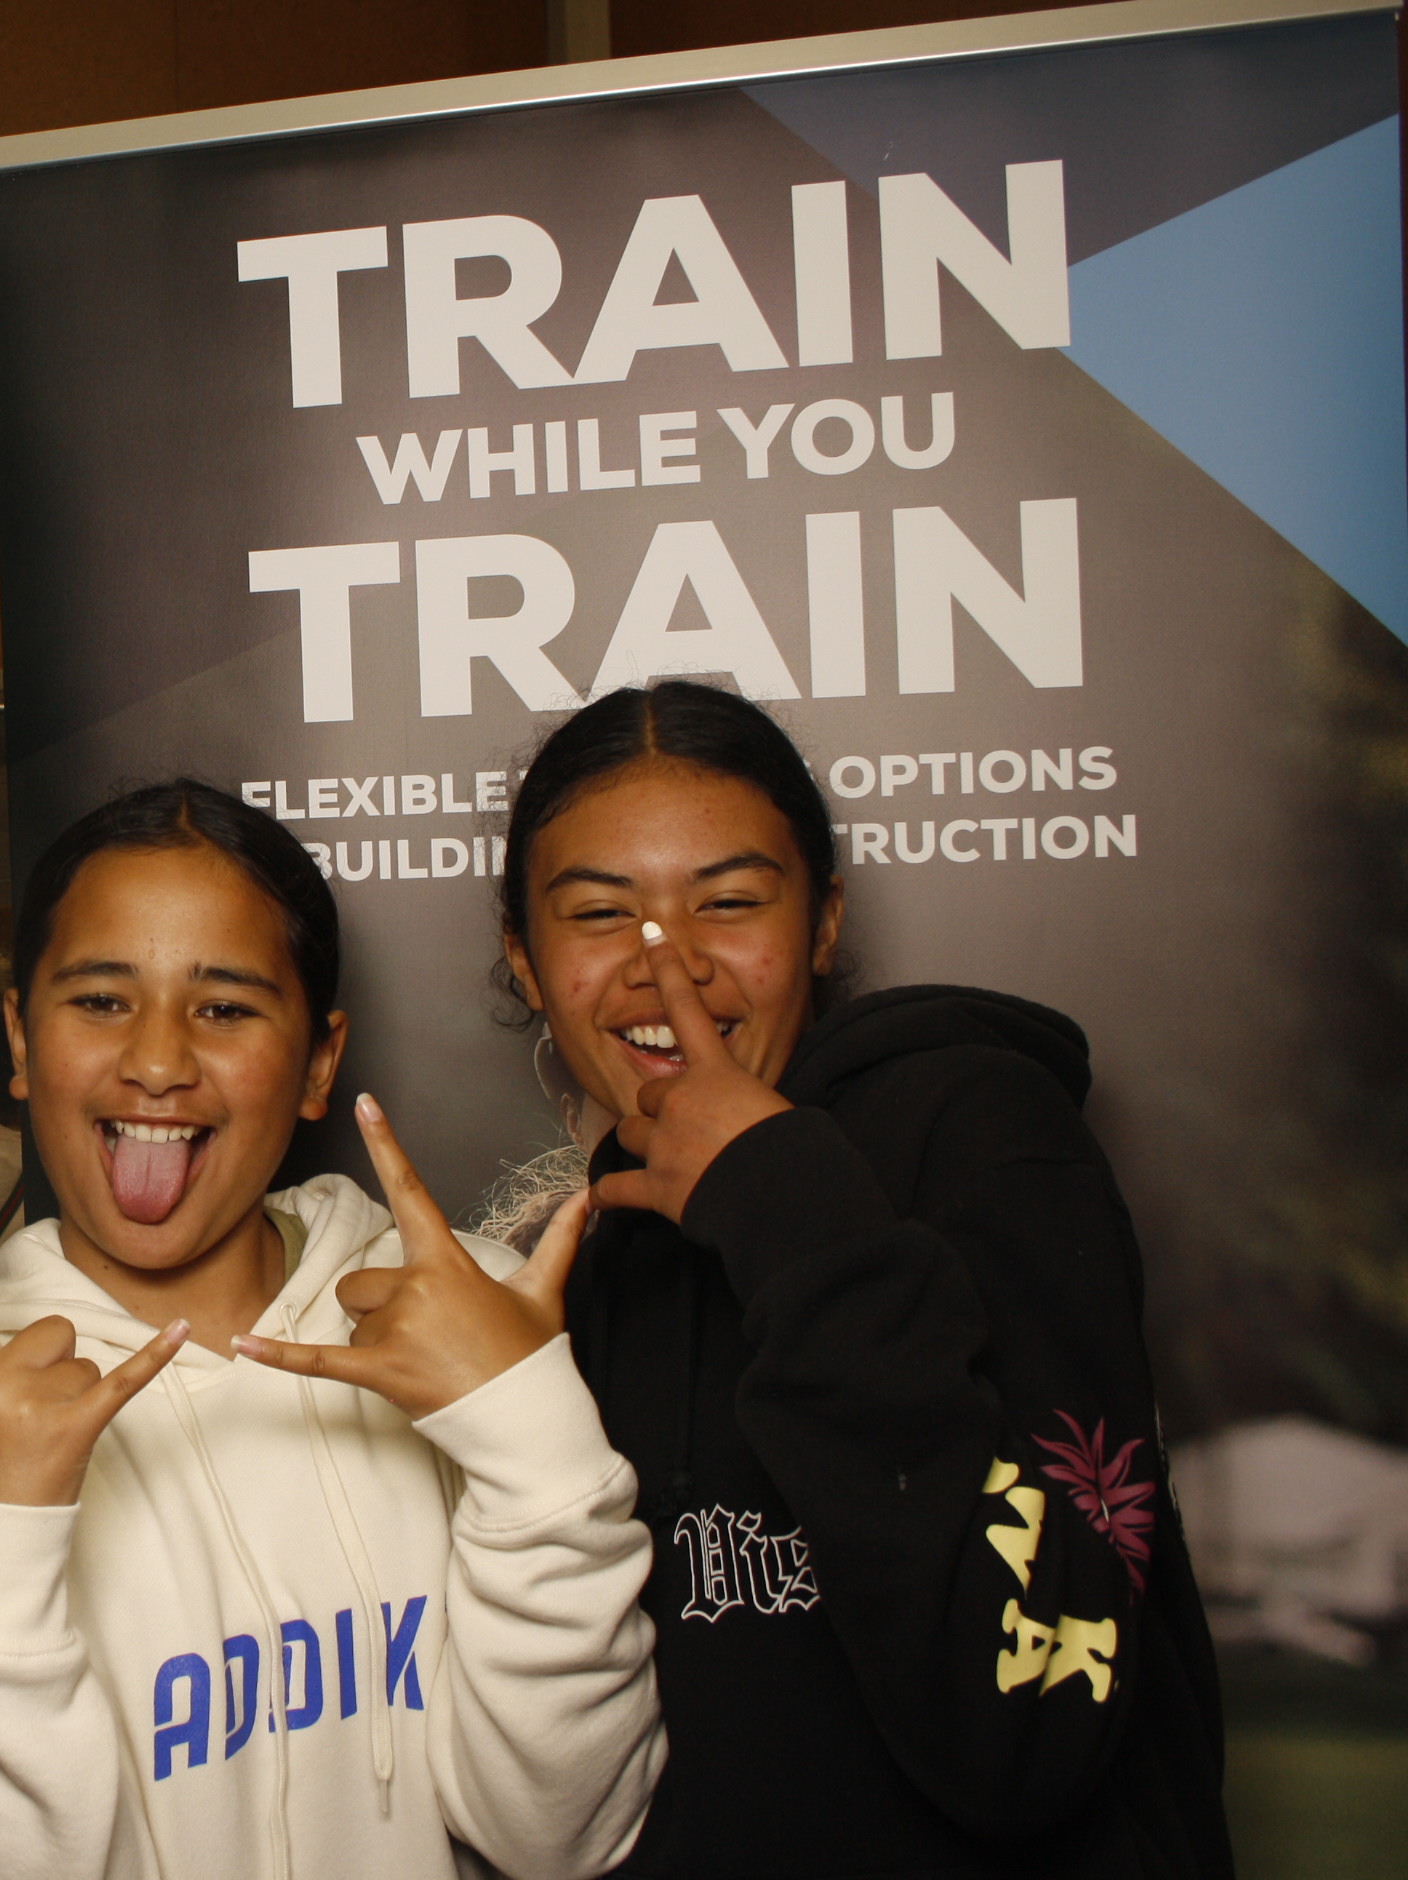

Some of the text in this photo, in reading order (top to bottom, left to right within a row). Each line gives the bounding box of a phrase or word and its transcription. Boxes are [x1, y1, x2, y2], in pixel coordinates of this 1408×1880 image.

[237, 159, 1071, 408] TRAIN
[356, 391, 955, 504] WHILE YOU
[248, 498, 1083, 723] TRAIN
[241, 770, 510, 820] FLEXIBLE
[829, 746, 1118, 799] OPTIONS
